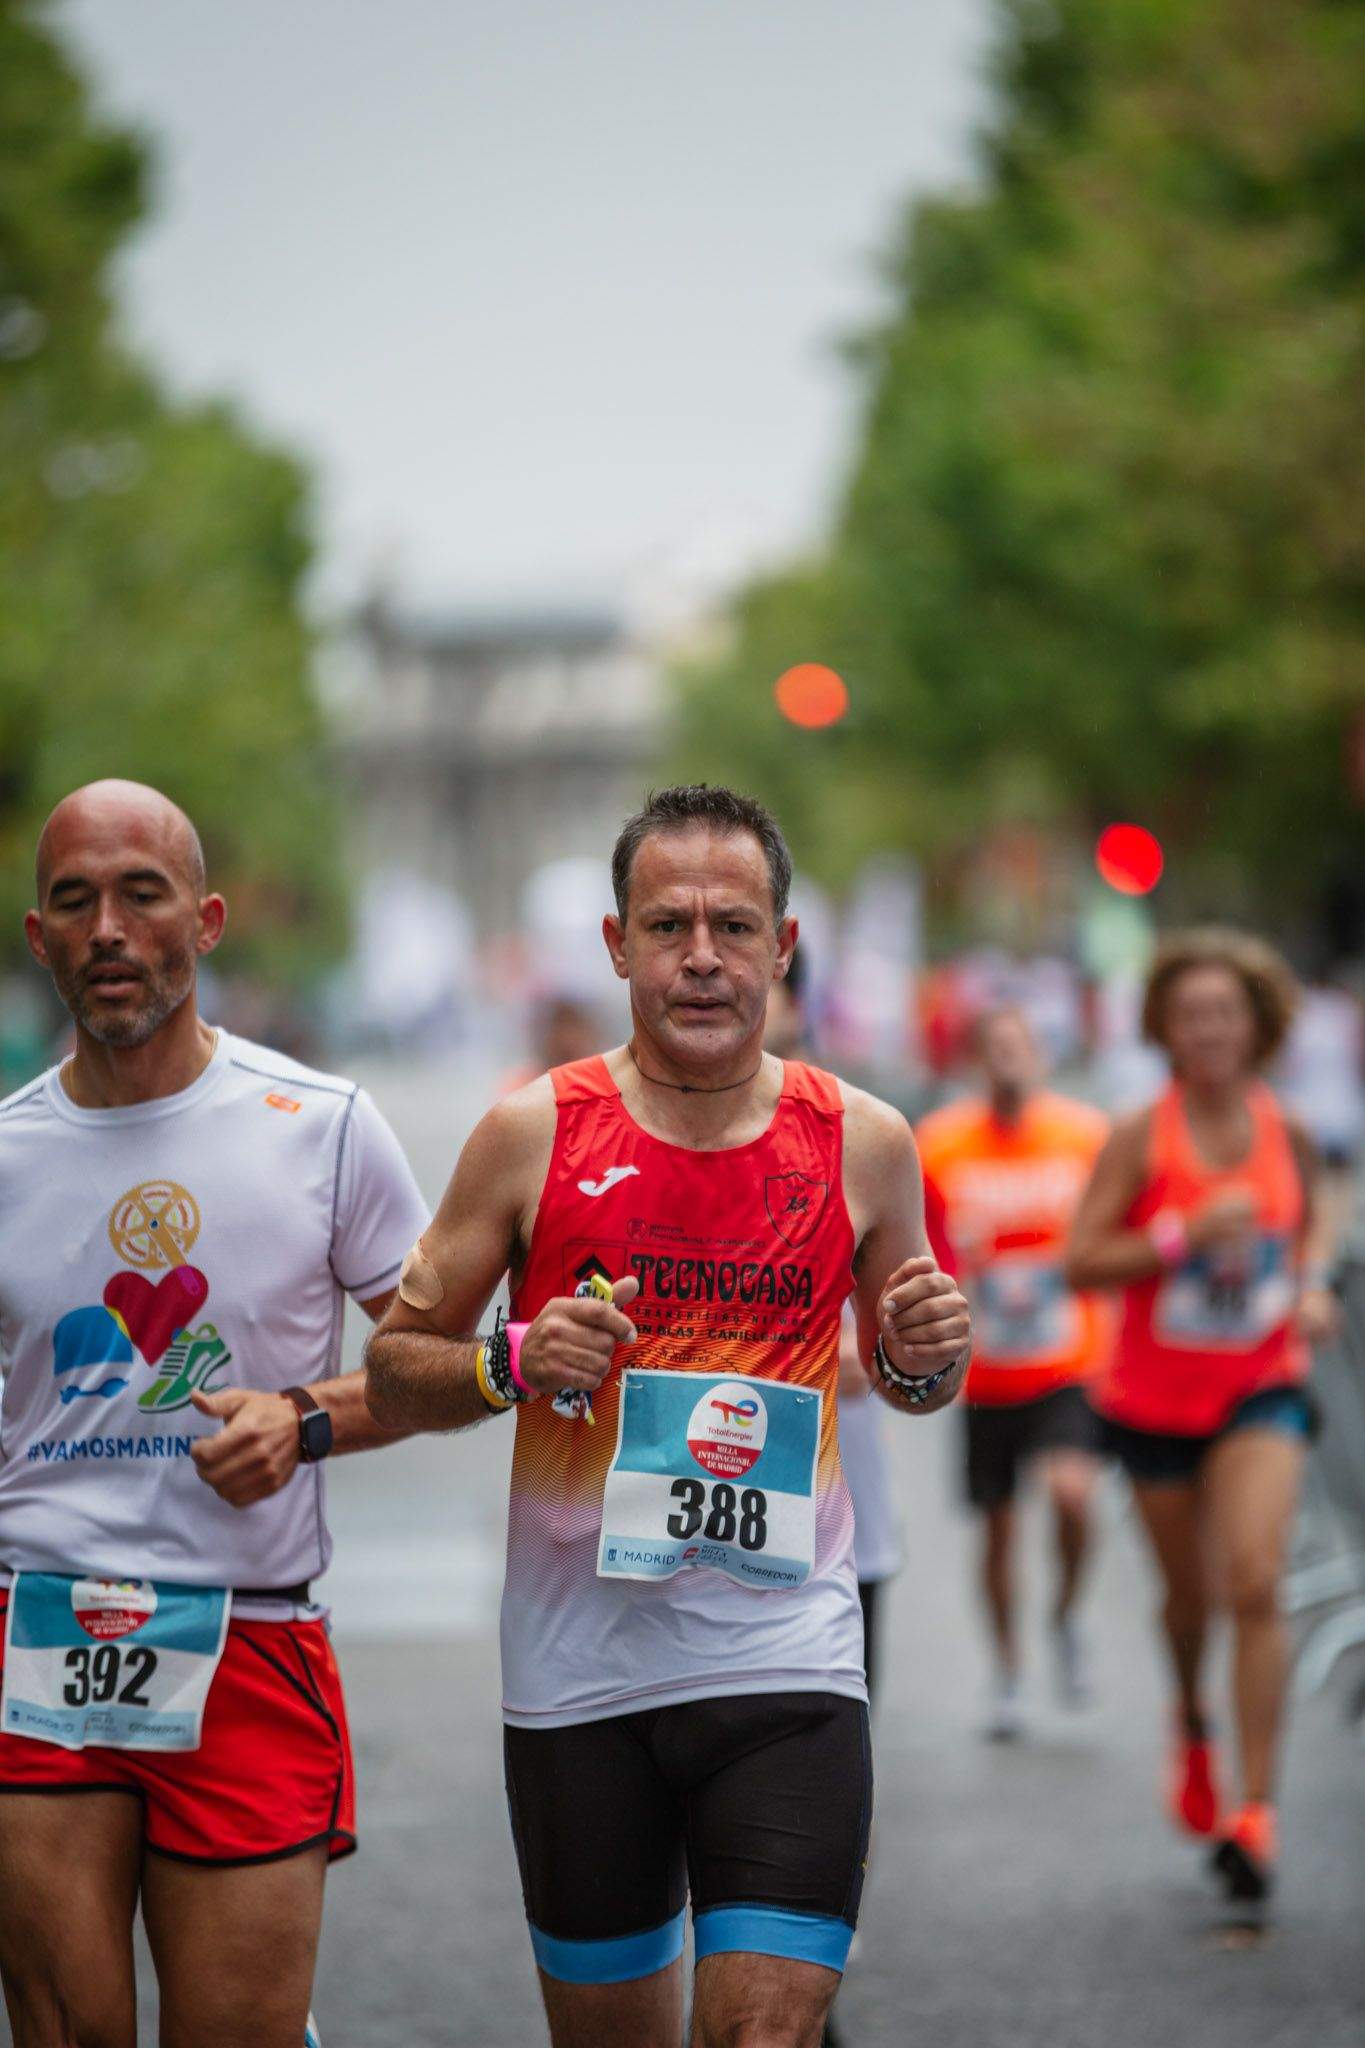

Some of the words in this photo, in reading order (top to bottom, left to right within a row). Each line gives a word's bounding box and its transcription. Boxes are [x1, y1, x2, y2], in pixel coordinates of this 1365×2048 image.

[631, 1254, 813, 1308] TECNOCASA
[656, 1325, 695, 1338] BLAS
[707, 1426, 753, 1440] TotalEnergies
[27, 1436, 200, 1462] #VAMOSMARIN
[717, 1445, 738, 1456] MILLA
[667, 1478, 767, 1551] 388
[624, 1551, 675, 1566] MADRID
[63, 1646, 158, 1707] 392
